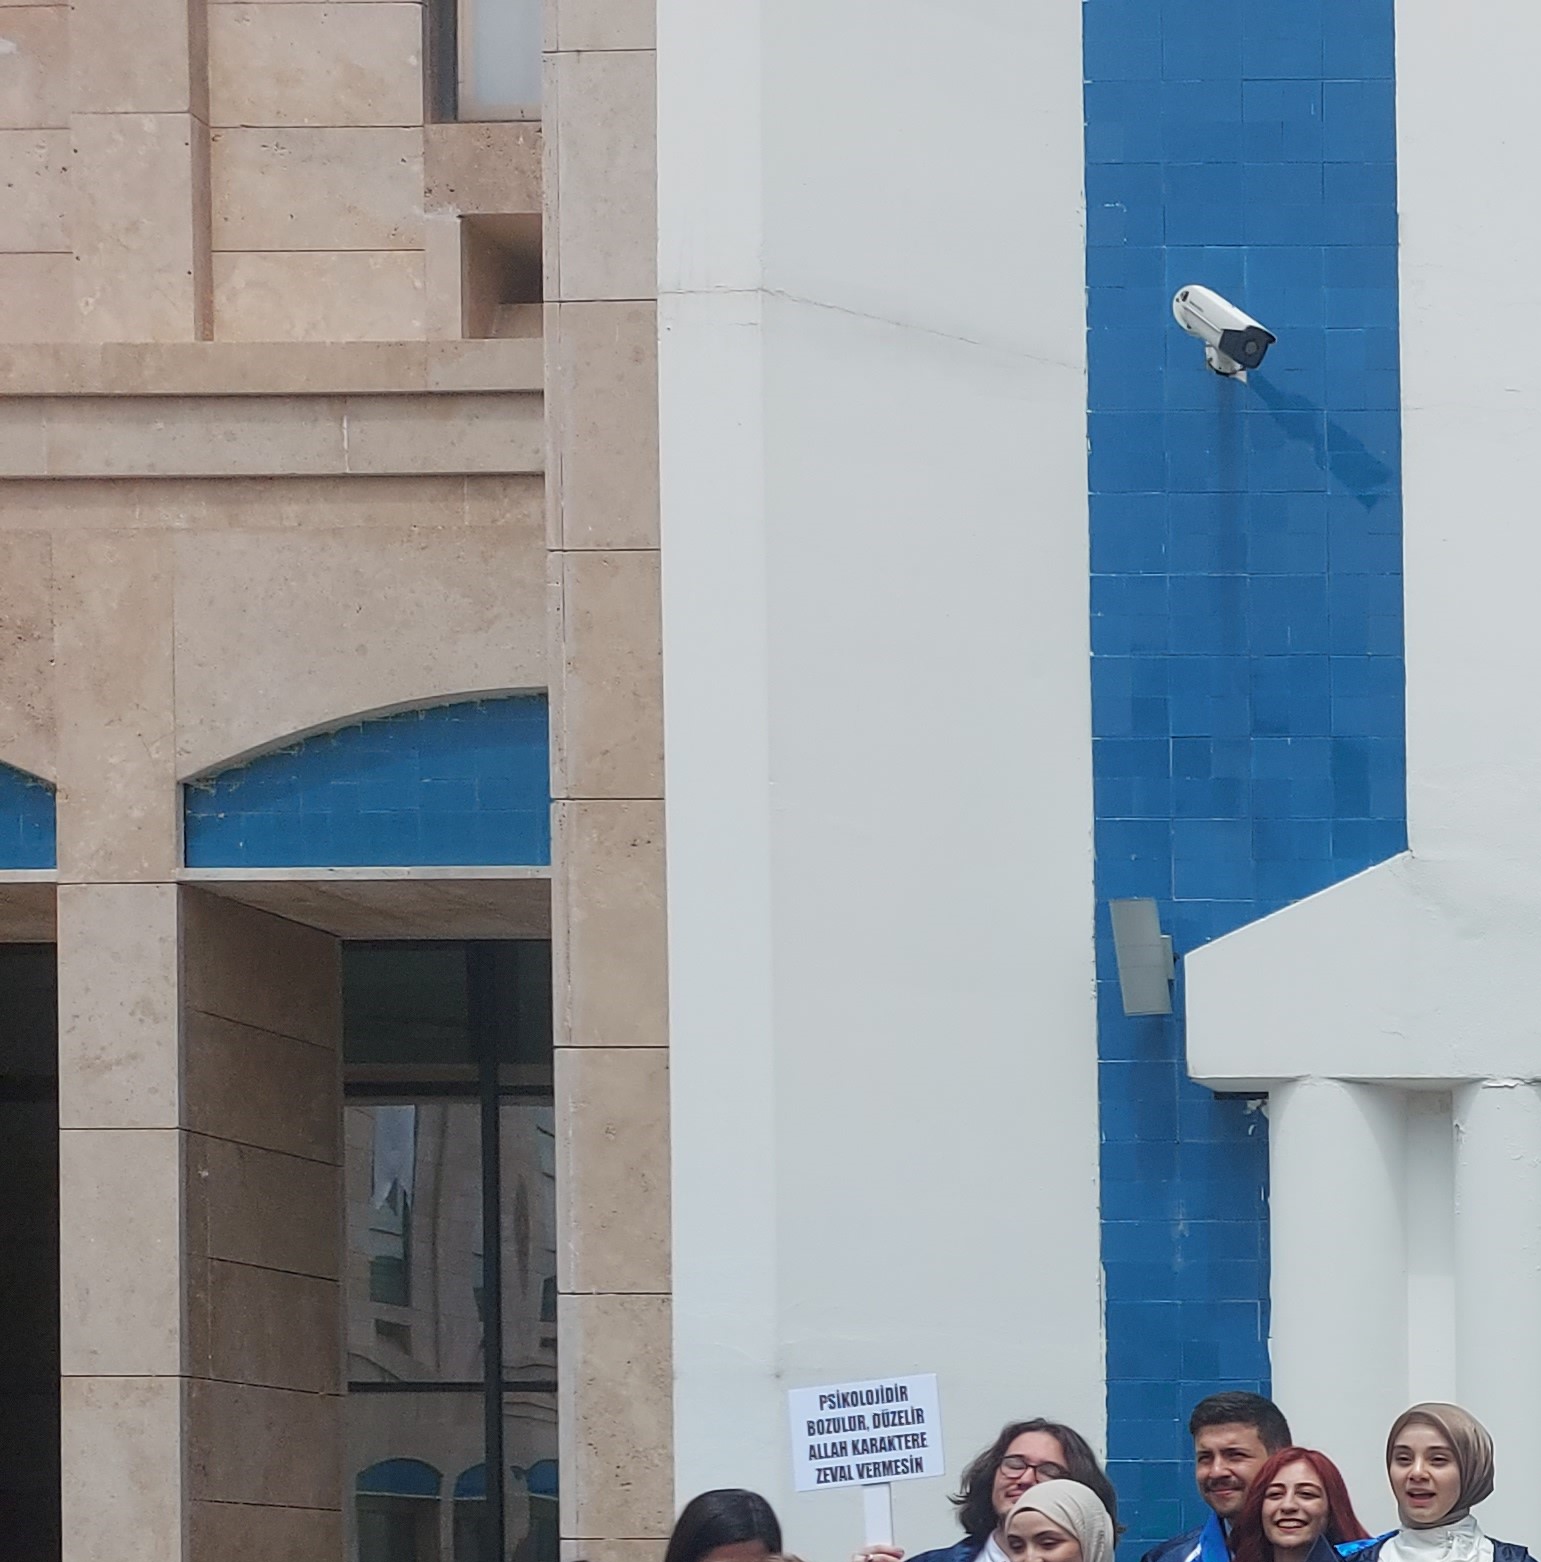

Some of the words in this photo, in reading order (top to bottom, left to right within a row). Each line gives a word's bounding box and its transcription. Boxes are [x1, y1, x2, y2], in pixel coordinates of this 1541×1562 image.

[819, 1383, 909, 1411] PSİKOLOJİDİR
[807, 1414, 870, 1437] BOZULUR,
[872, 1406, 925, 1429] DÜZELİR
[808, 1440, 848, 1461] ALLAH
[852, 1432, 928, 1456] KARAKTERE
[816, 1464, 855, 1484] ZEVAL
[856, 1454, 924, 1480] VERMESİN
